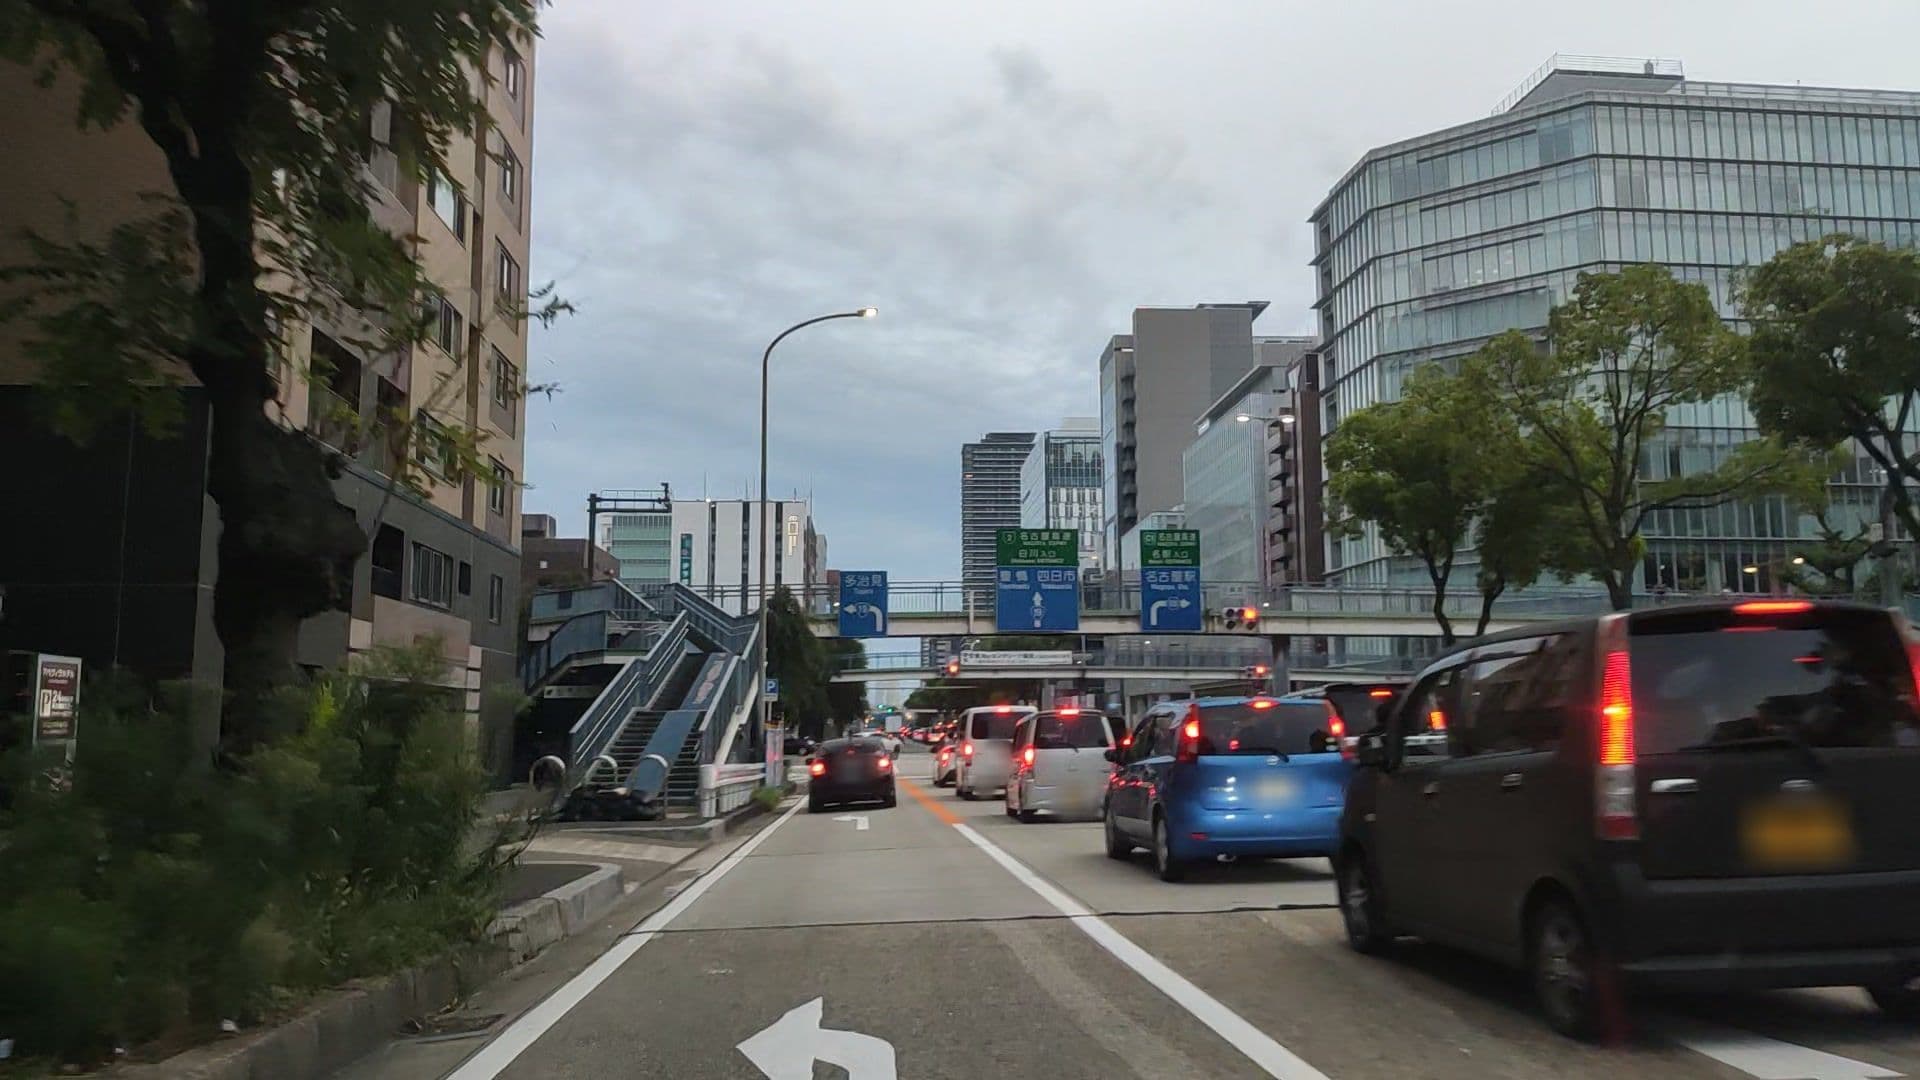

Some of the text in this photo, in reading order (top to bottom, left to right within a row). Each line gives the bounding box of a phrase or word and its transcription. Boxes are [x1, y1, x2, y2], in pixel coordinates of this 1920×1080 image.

[845, 574, 883, 588] 多治見
[1037, 570, 1076, 582] 四日市
[1145, 570, 1196, 583] 名古屋駅
[767, 681, 776, 692] P
